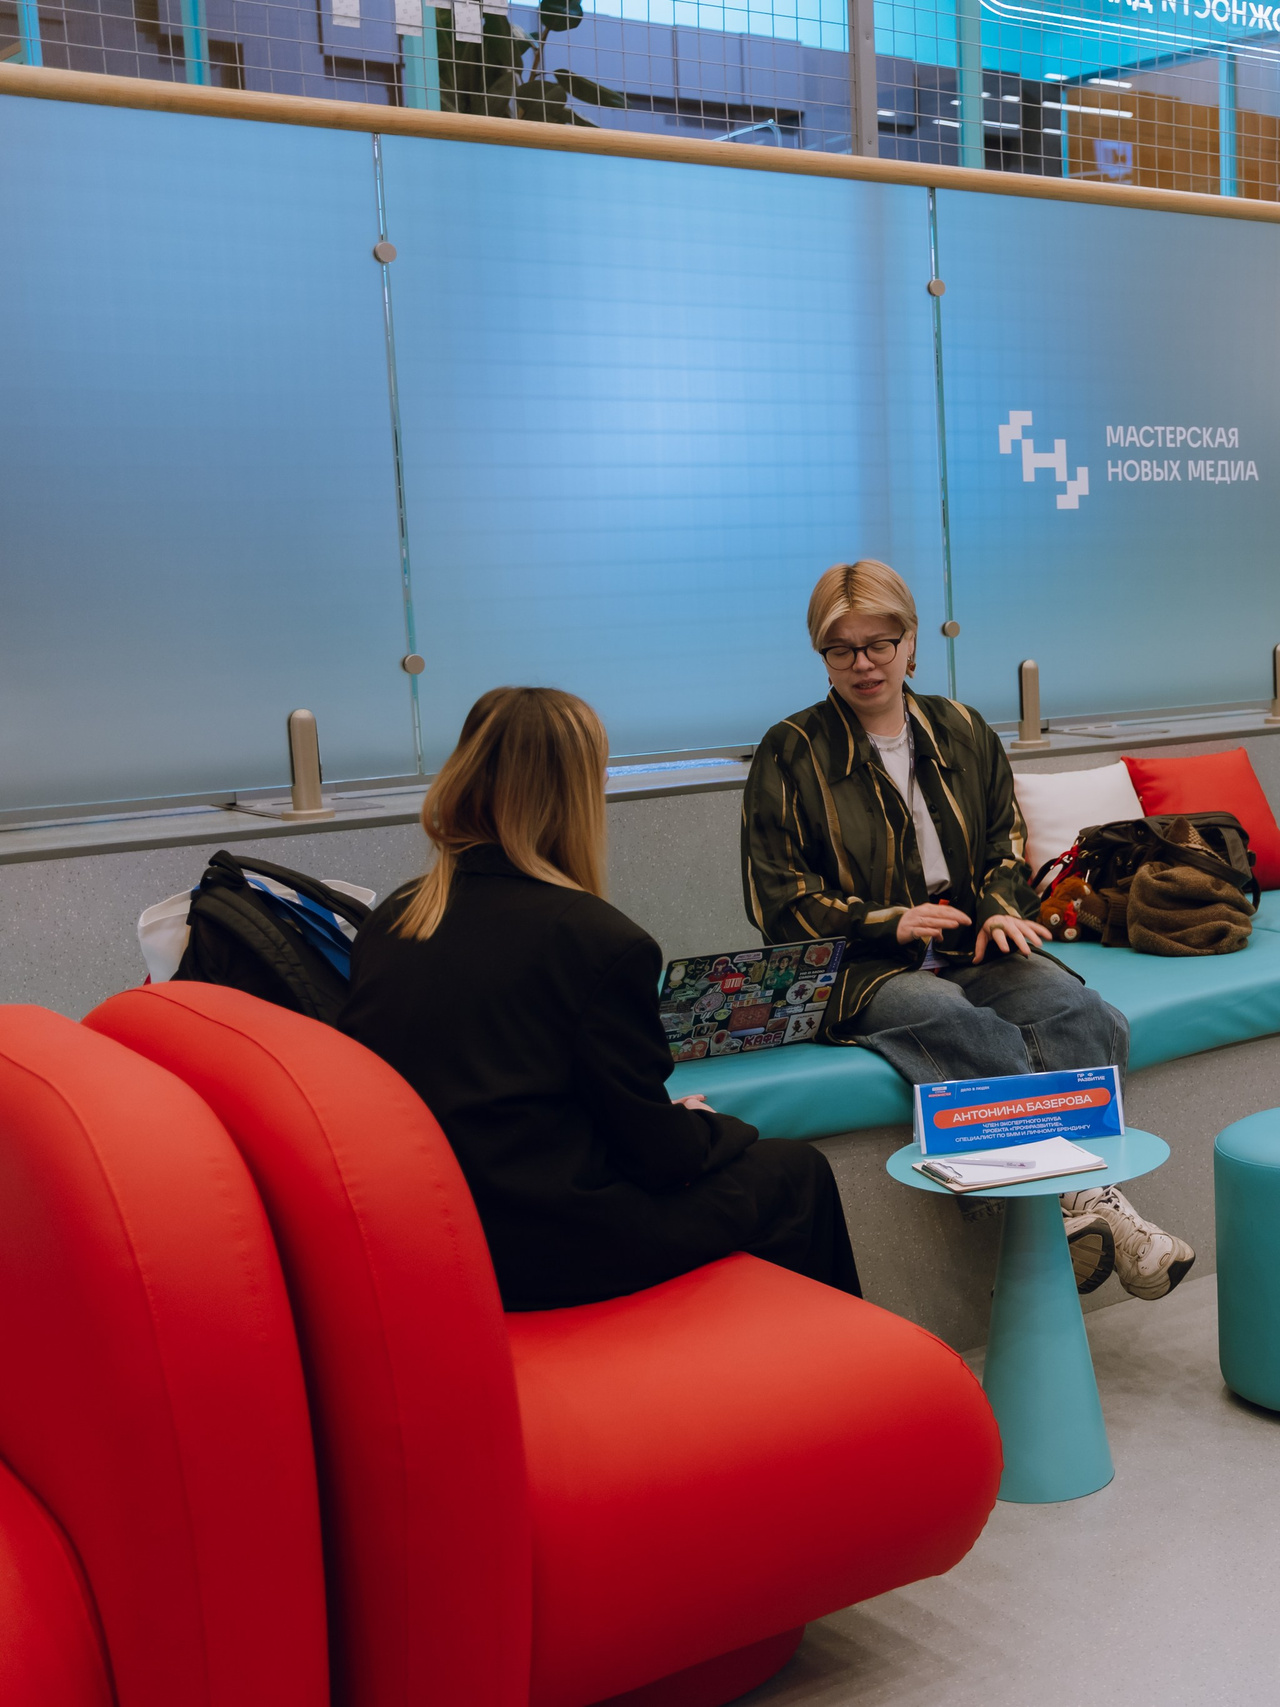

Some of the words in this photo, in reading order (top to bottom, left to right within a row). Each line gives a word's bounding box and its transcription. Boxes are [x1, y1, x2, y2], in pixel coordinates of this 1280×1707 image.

[1105, 425, 1239, 449] МАСТЕРСКАЯ
[1107, 459, 1182, 482] НОВЫХ
[1188, 460, 1259, 485] МЕДИА
[952, 1104, 1025, 1123] АНТОНИНА
[1026, 1094, 1093, 1112] БАЗЕРОВА
[955, 1133, 996, 1143] СПЕЦИАЛИСТ
[1026, 1128, 1057, 1136] ЛИЧНОМУ
[1056, 1124, 1091, 1133] БРЕНДИНГУ
[1000, 1118, 1042, 1127] ЭКСПЕРТНОГО
